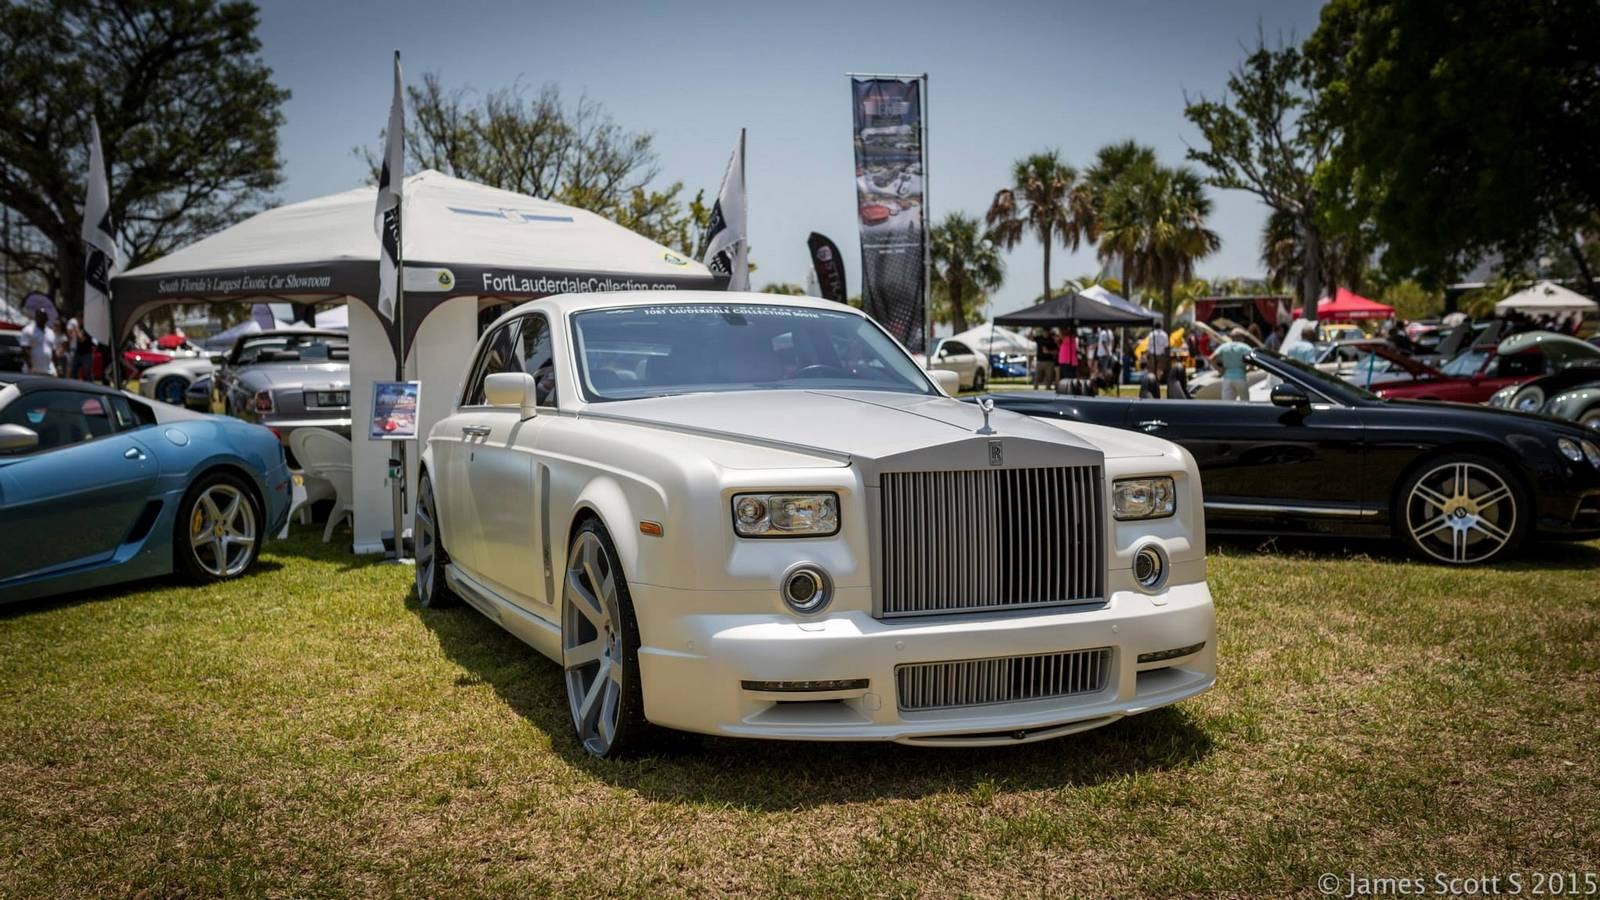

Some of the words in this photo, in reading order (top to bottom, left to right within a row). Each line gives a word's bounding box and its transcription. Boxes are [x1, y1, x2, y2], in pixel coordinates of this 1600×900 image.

[158, 280, 179, 293] South
[180, 278, 212, 292] Florida's
[213, 277, 241, 294] Largest
[242, 276, 268, 290] Exotic
[269, 275, 285, 288] Car
[286, 274, 331, 288] Showroom
[482, 272, 677, 294] FortLauderdaleCollectioncom
[733, 308, 792, 316] COLLECTION
